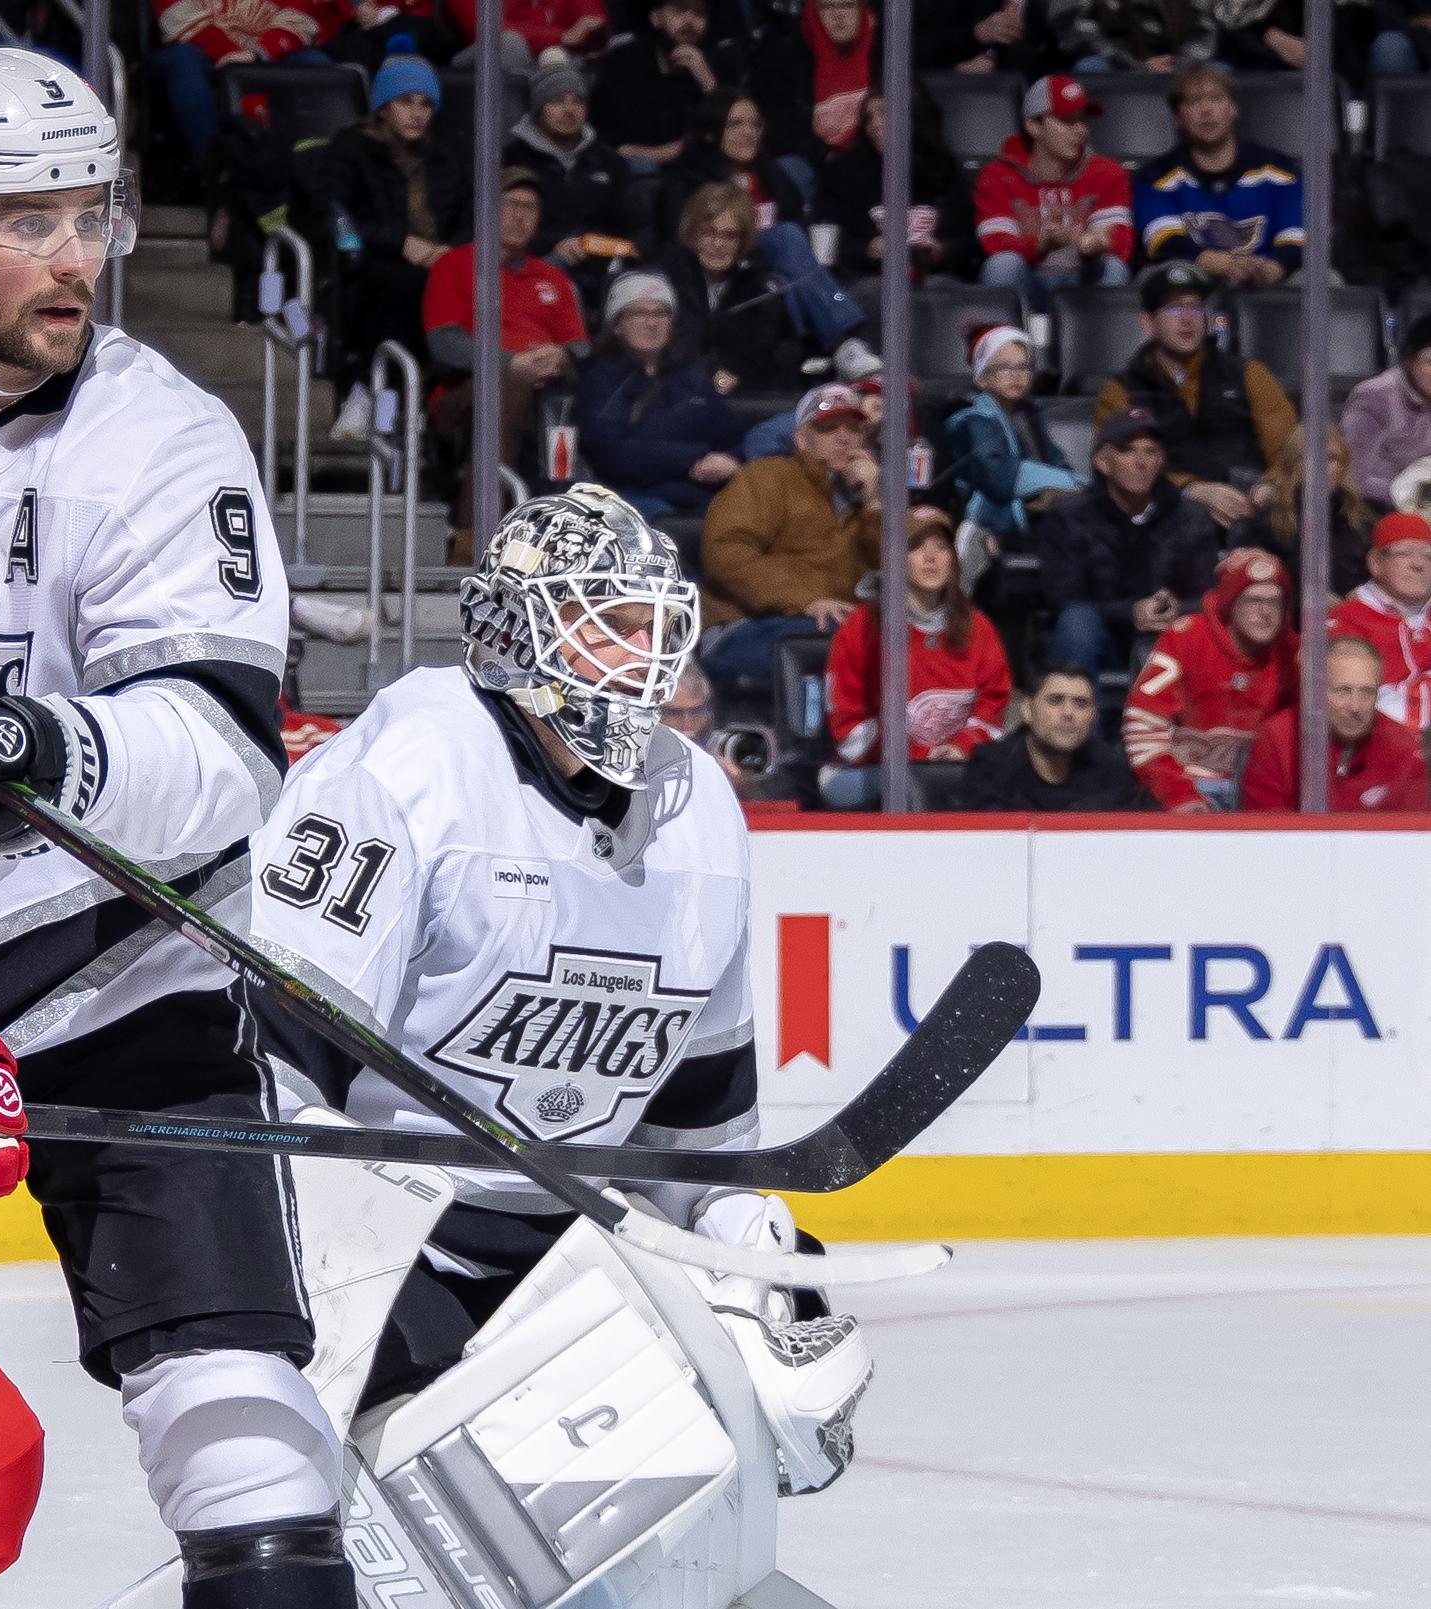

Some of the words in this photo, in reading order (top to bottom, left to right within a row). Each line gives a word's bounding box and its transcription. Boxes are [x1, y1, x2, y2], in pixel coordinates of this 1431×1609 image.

[40, 125, 98, 141] WARRIOR
[4, 487, 39, 585] A
[209, 486, 264, 603] 9
[260, 812, 397, 938] 31
[494, 872, 522, 883] IRON
[525, 874, 550, 886] BOW
[561, 969, 585, 986] Los
[587, 972, 643, 993] Angeles
[465, 992, 693, 1080] KINGS
[127, 1123, 221, 1139] SUPERCHARGED
[222, 1129, 246, 1140] MID
[248, 1132, 312, 1146] KICKPOINT
